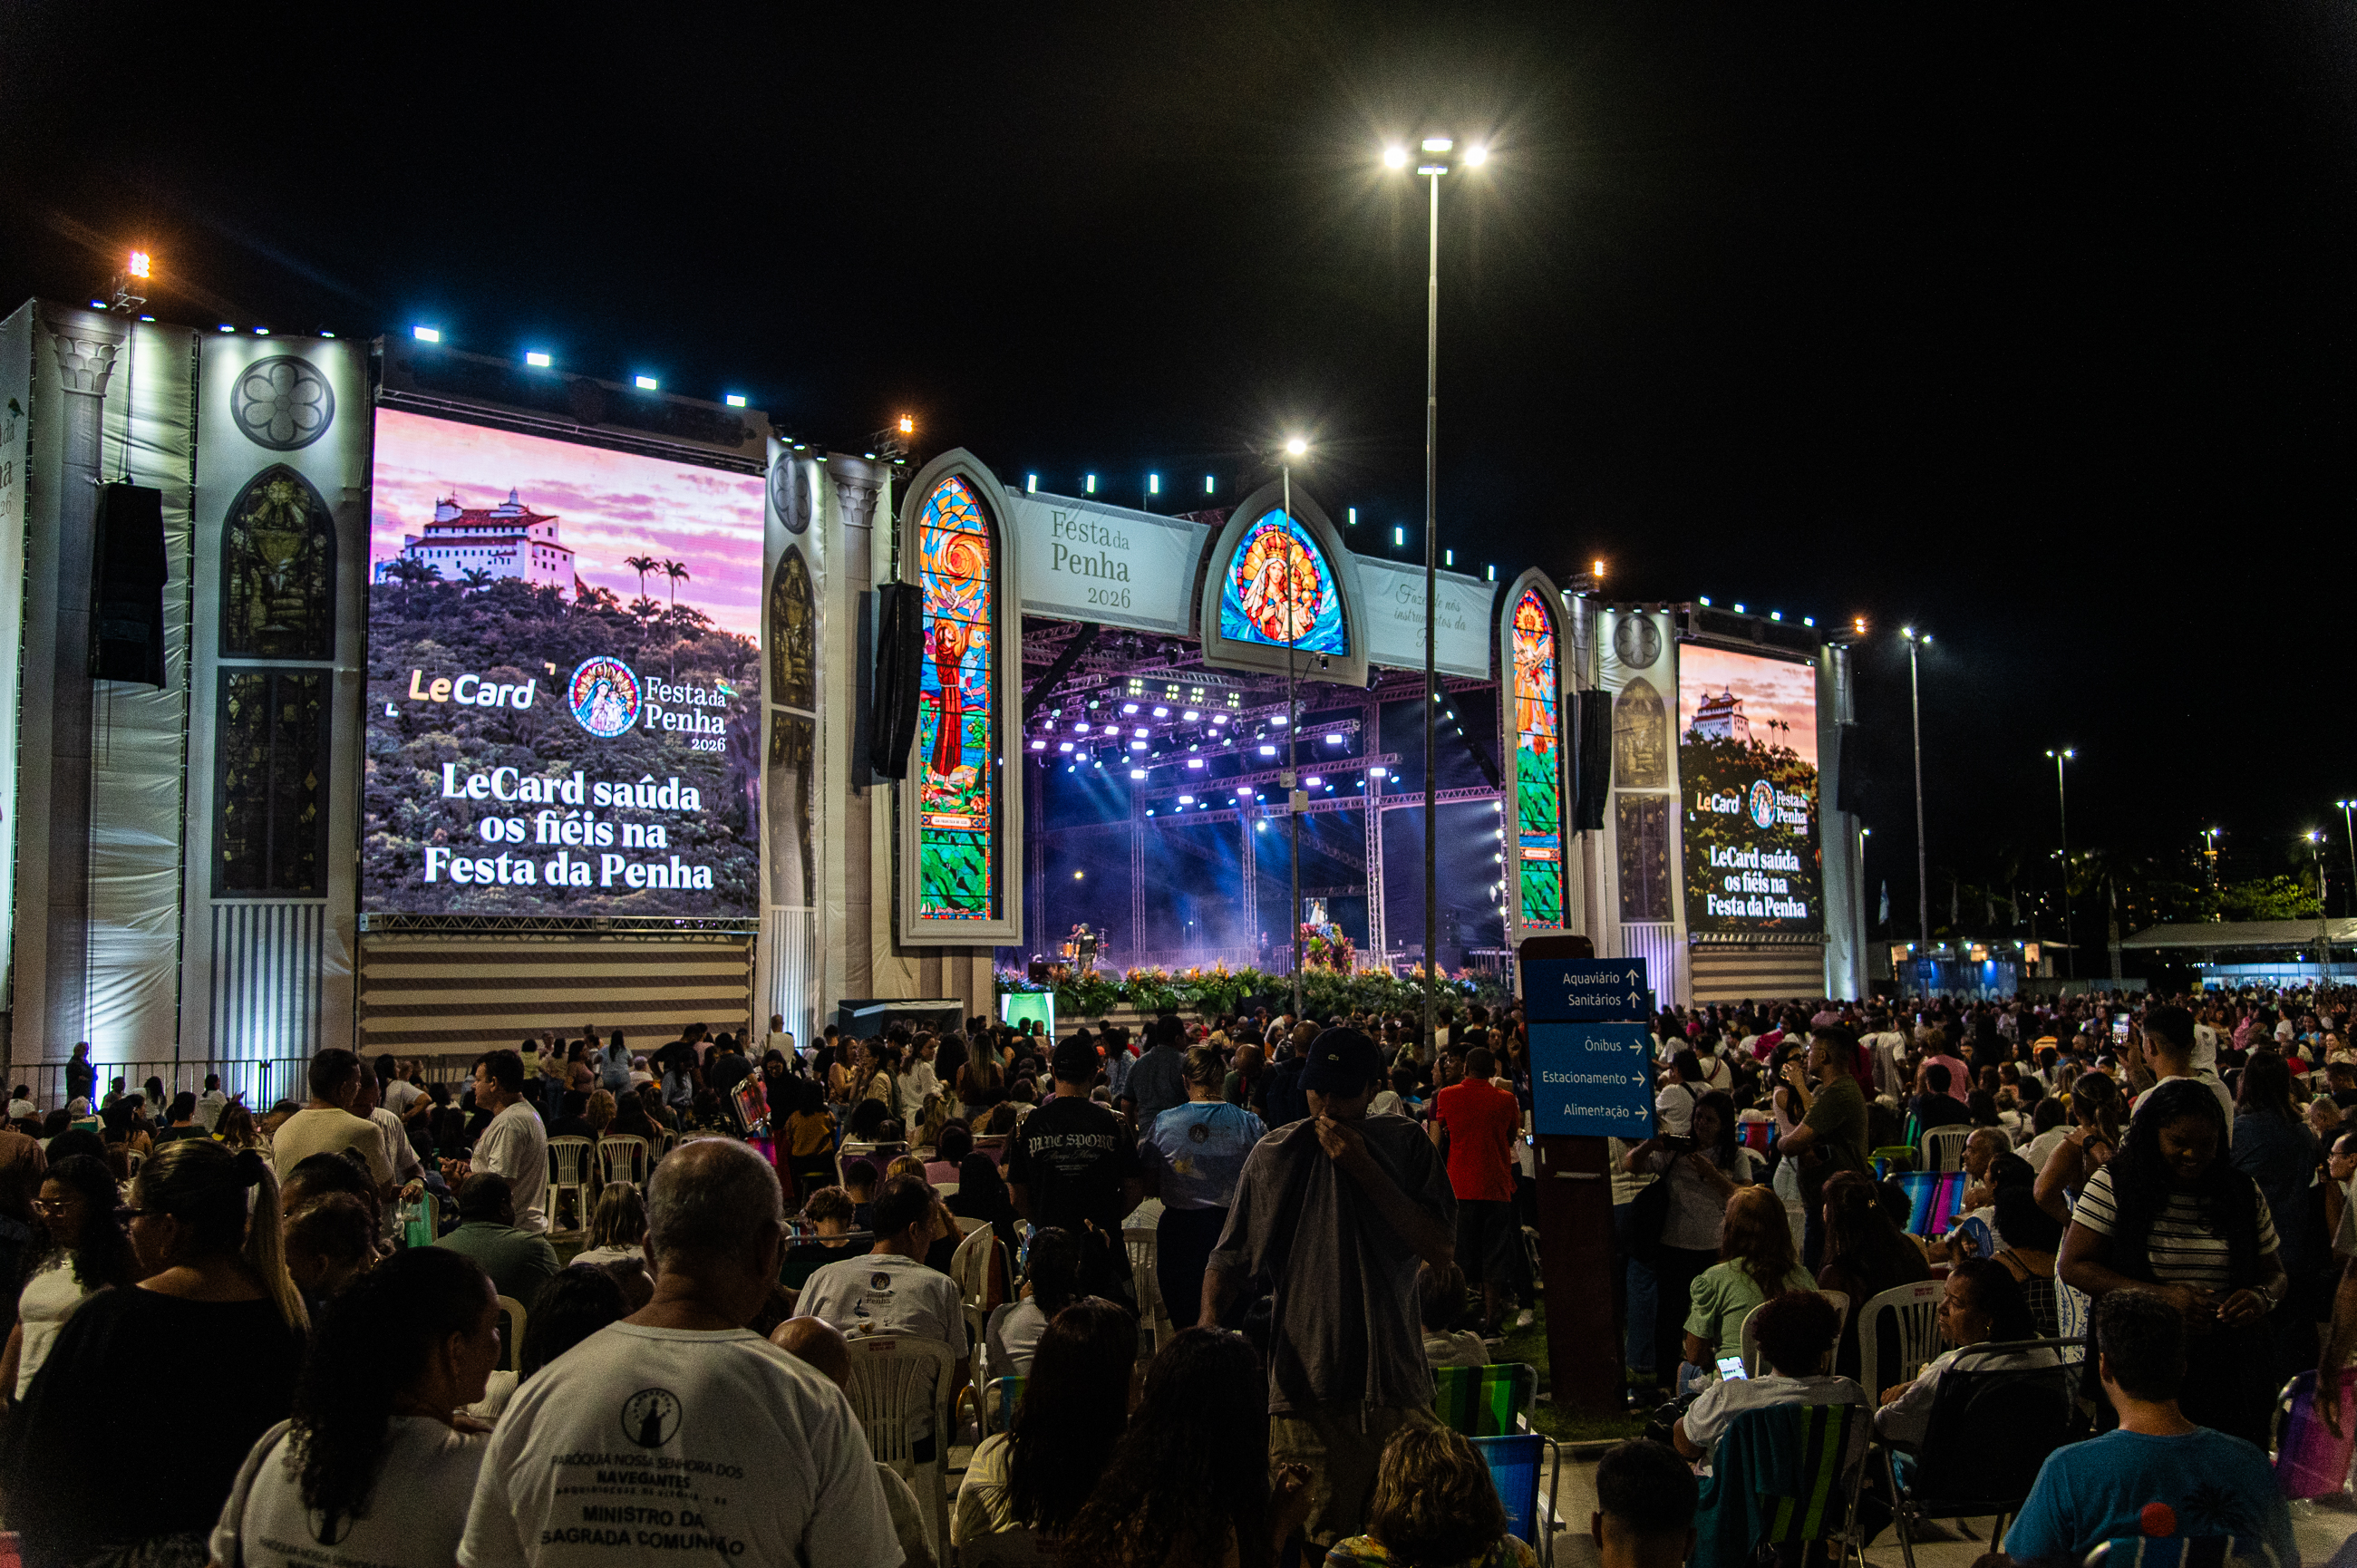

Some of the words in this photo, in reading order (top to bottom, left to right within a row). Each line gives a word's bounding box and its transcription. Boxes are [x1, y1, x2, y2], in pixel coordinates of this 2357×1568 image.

[1051, 510, 1111, 547] Festa
[1112, 530, 1130, 551] da
[1051, 543, 1130, 583] Penha
[1088, 587, 1130, 609] 2026
[1454, 615, 1466, 631] da
[408, 669, 536, 711] LeCard
[645, 675, 707, 706] Festa
[708, 680, 726, 708] da
[645, 702, 726, 735] Penha
[692, 737, 726, 752] 2026
[441, 761, 585, 806] LeCard
[593, 773, 701, 812] saúda
[1696, 792, 1741, 815] LeCard
[1776, 789, 1799, 808] Festa
[1776, 806, 1809, 825] Penha
[480, 816, 526, 844] os
[534, 808, 615, 848] fiéis
[622, 822, 668, 849] na
[423, 847, 537, 886] Festa
[544, 850, 592, 887] da
[600, 852, 713, 890] Penha
[1710, 844, 1760, 869] LeCard
[1760, 847, 1800, 872] saúda
[1724, 875, 1741, 892] os
[1741, 870, 1770, 894] fiéis
[1770, 877, 1789, 895] na
[1706, 893, 1746, 917] Festa
[1746, 895, 1764, 917] da
[1764, 895, 1809, 919] Penha
[1563, 971, 1620, 986] Aquaviário
[1568, 993, 1621, 1006] Sanitários
[1585, 1036, 1622, 1051] Ônibus
[1542, 1070, 1627, 1085] Estacionamento
[1564, 1103, 1629, 1119] Alimentação
[657, 1457, 714, 1475] SENHORA
[715, 1463, 743, 1479] DOS
[597, 1470, 690, 1489] NAVEGANTES
[583, 1505, 674, 1526] MINISTRO
[681, 1509, 705, 1529] DA
[540, 1527, 632, 1546] SAGRADA
